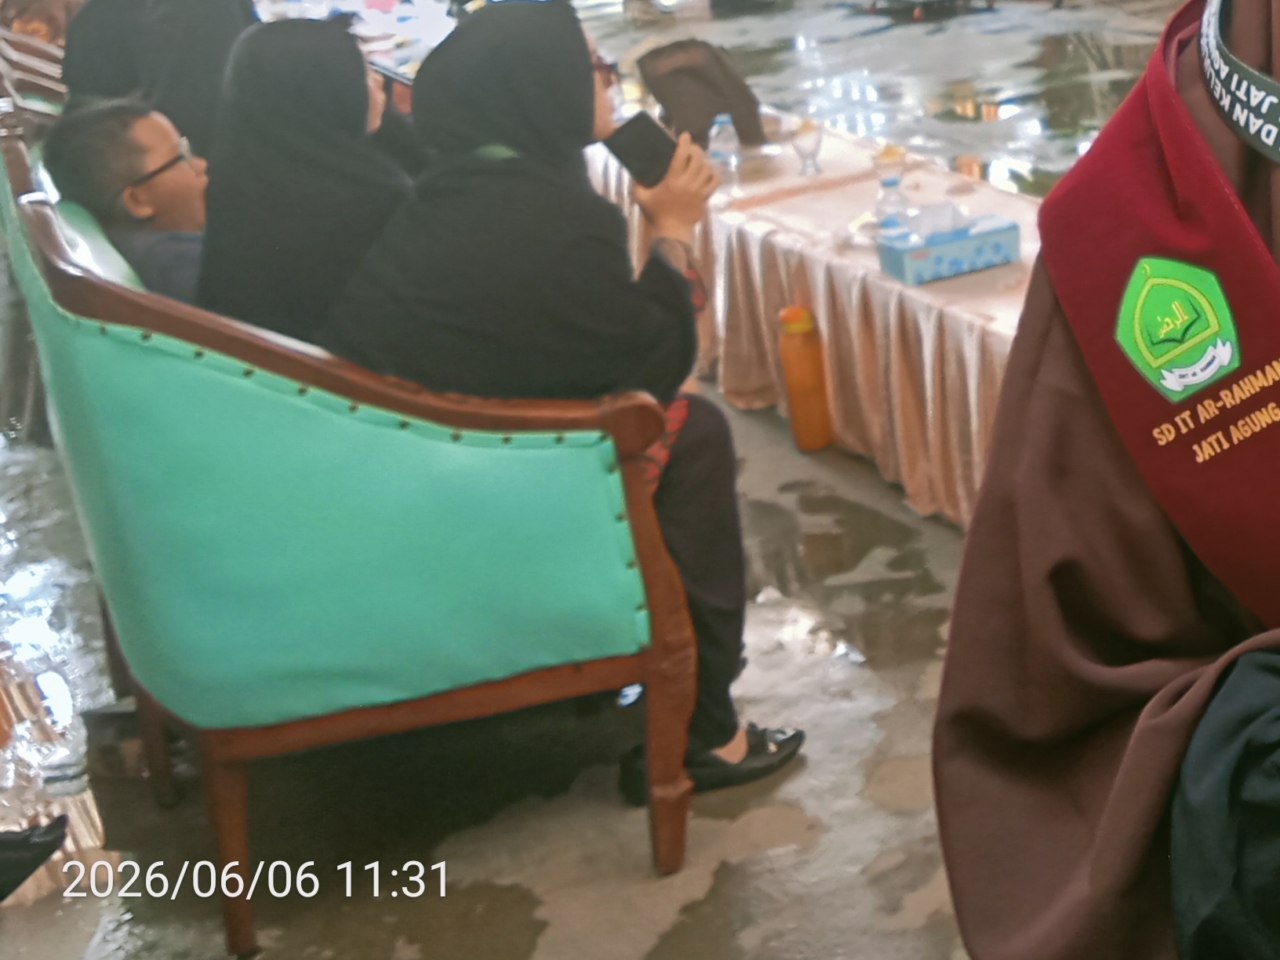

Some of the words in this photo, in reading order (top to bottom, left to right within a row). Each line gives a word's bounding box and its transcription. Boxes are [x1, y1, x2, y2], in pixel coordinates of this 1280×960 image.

[1230, 73, 1279, 114] JATI
[1232, 102, 1279, 147] DAN
[1152, 422, 1176, 446] SD
[1174, 410, 1195, 434] IT
[1192, 430, 1230, 463] JATI
